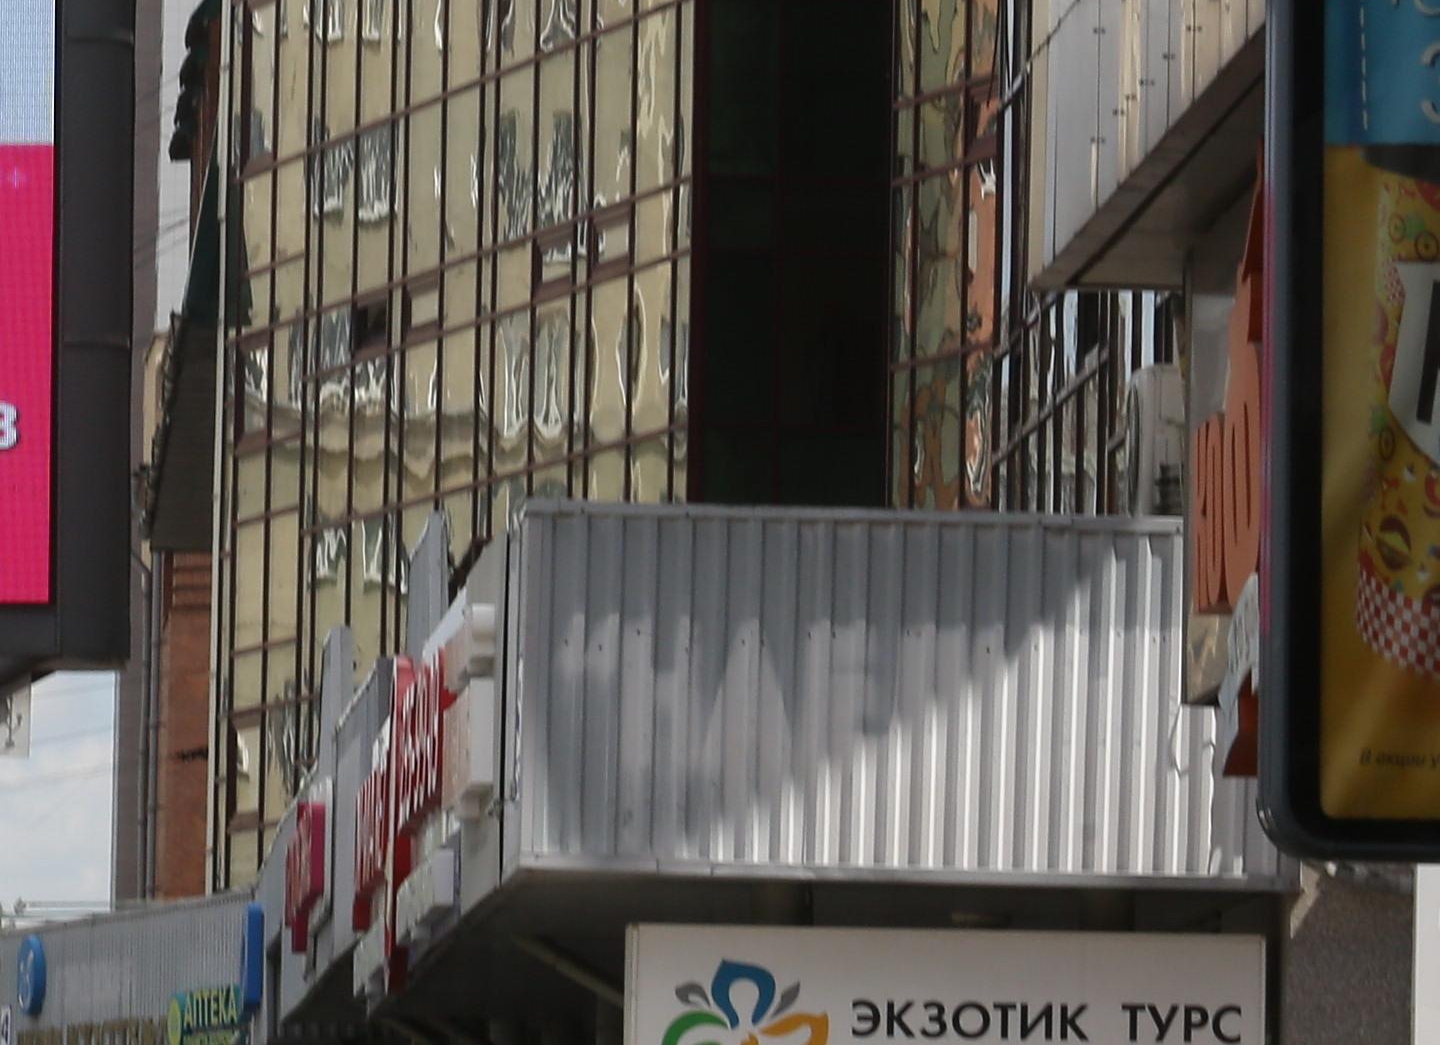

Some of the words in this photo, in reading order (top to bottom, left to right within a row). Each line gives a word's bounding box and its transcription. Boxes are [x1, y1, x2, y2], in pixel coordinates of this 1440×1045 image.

[183, 981, 238, 1029] АПТЕКА
[851, 999, 1088, 1041] ЭКЗОТИК
[1121, 1002, 1243, 1044] ТУРС
